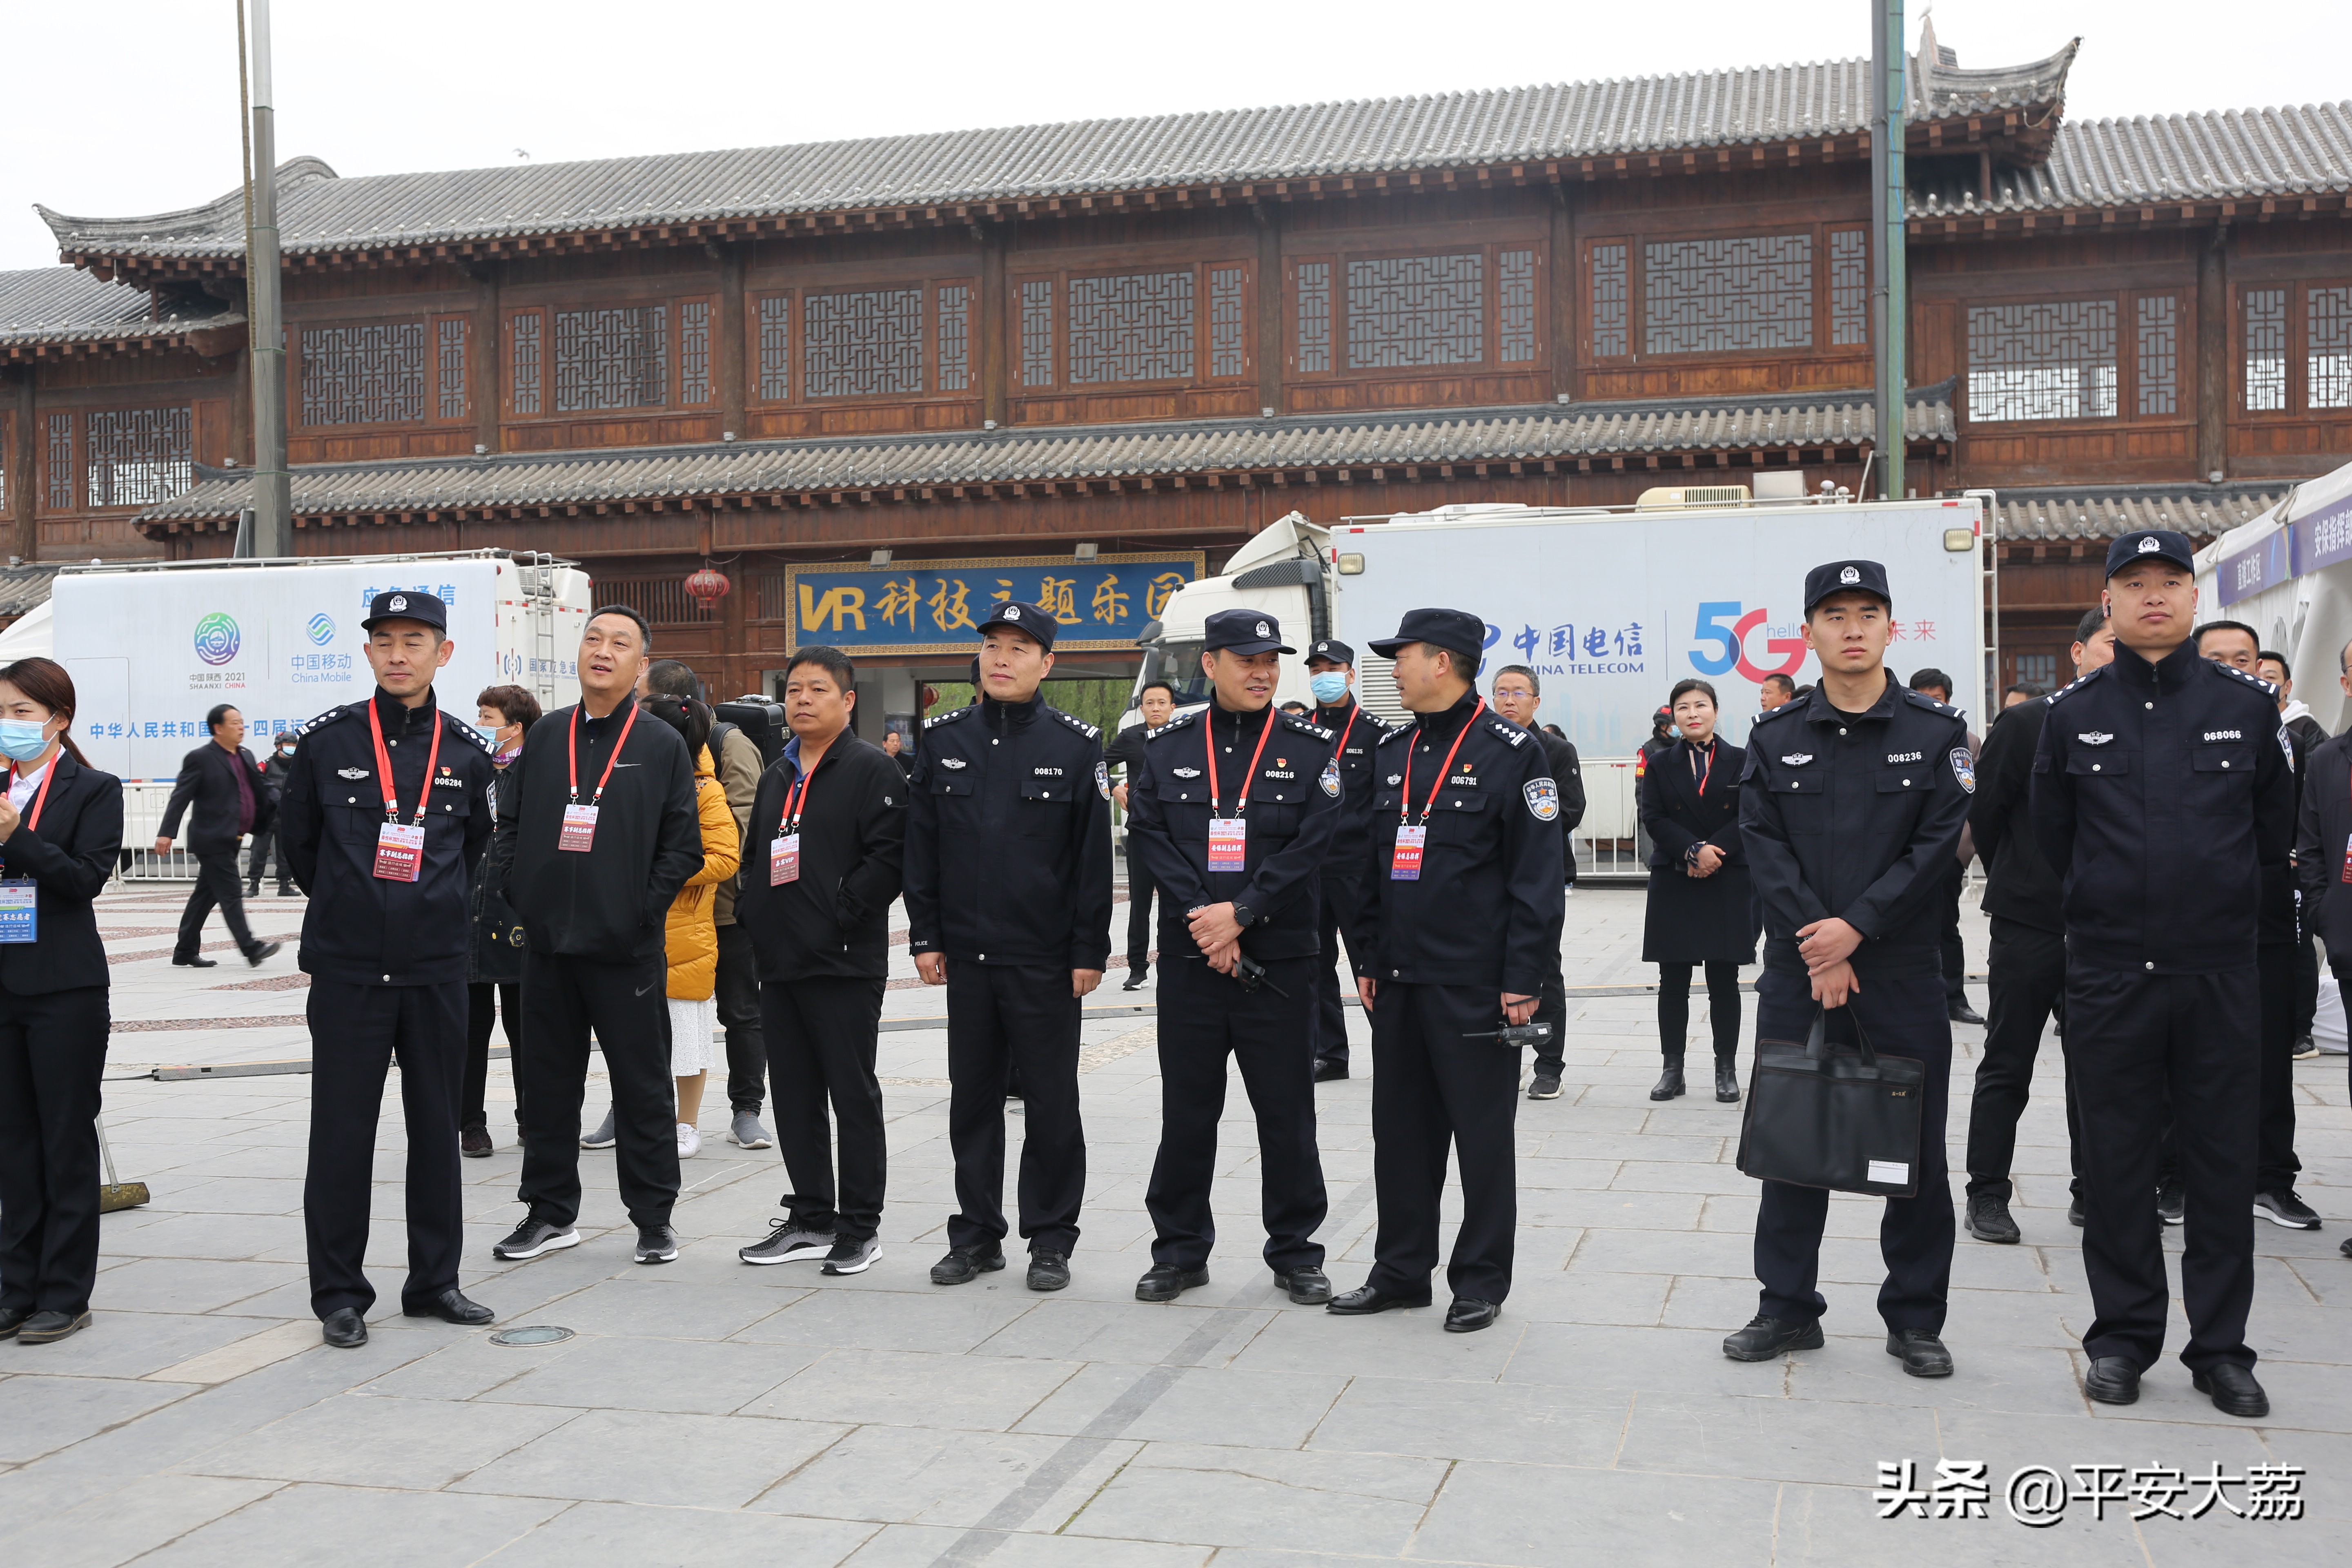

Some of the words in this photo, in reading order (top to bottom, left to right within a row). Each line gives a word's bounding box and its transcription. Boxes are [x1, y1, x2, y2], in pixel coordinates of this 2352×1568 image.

[361, 584, 456, 608] 应信
[1513, 621, 1643, 664] 中国电信
[291, 653, 352, 670] 中国移动
[1568, 662, 1644, 675] TELECOM
[189, 673, 204, 682] 中国
[206, 673, 221, 682] 陕西
[225, 672, 245, 681] 2021
[292, 673, 318, 683] China
[321, 672, 352, 682] Mobile
[90, 718, 309, 739] 中华人民共和国四届运
[2203, 730, 2241, 742] 068066
[1888, 751, 1922, 763] 008236
[1034, 767, 1062, 775] 008170
[1265, 770, 1294, 779] 008216
[434, 777, 462, 788] 006284
[1451, 775, 1477, 786] 006791
